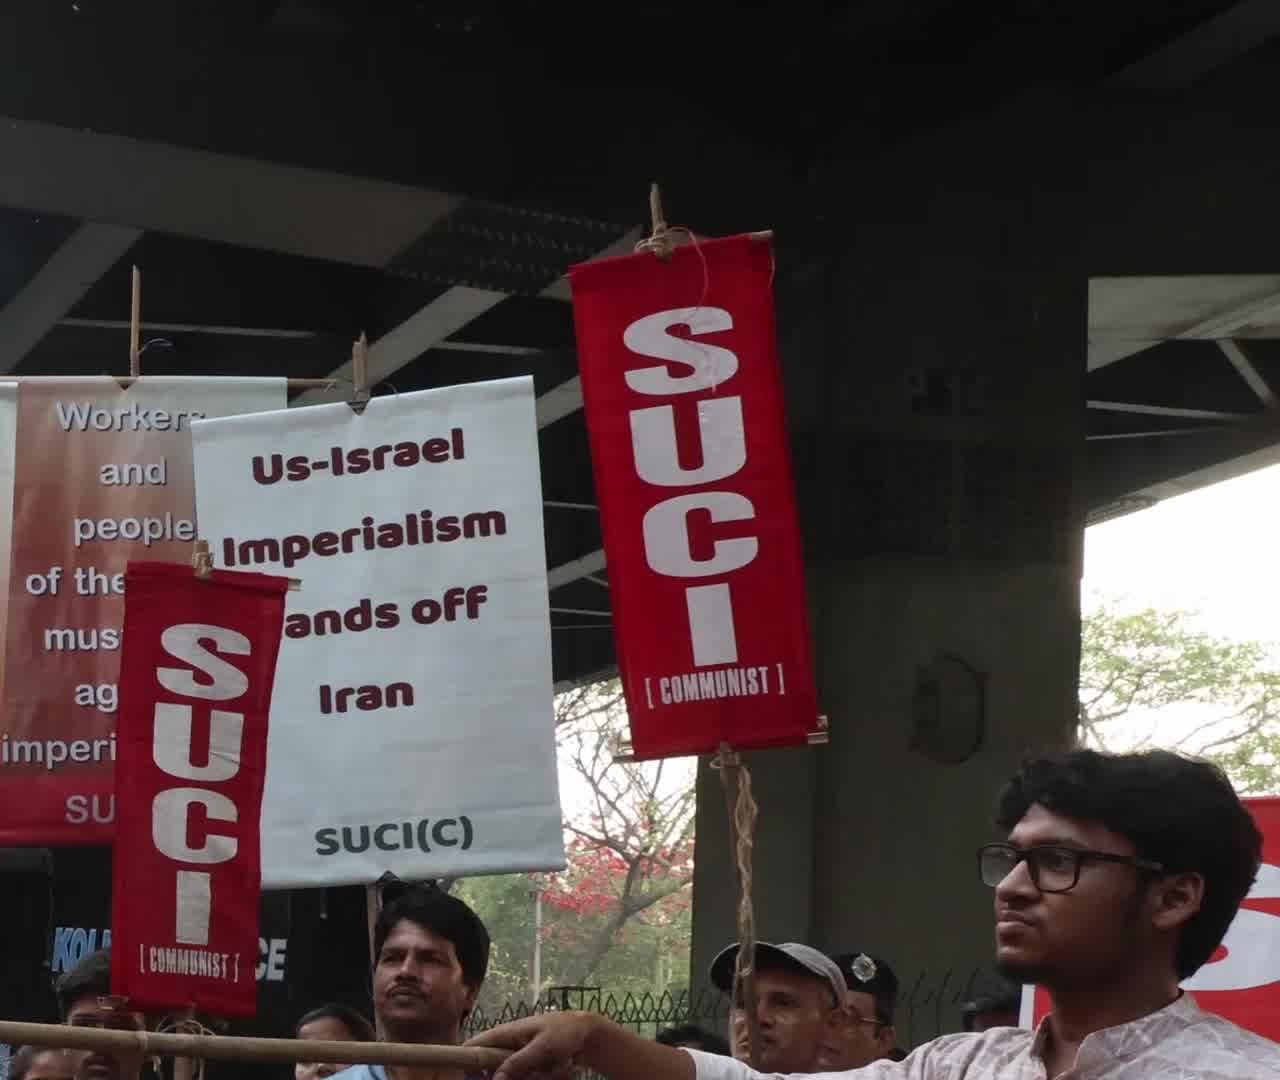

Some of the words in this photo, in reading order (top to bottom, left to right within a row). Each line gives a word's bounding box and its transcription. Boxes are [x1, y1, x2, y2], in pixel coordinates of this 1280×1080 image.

[99, 455, 167, 485] and
[252, 428, 465, 485] Us-Israel
[623, 306, 759, 667] SUCI
[74, 512, 195, 548] people
[223, 510, 507, 568] Imperialism
[26, 567, 64, 596] of
[74, 567, 124, 595] the
[285, 598, 400, 639] ands
[411, 585, 488, 625] off
[44, 627, 123, 651] mus
[319, 682, 414, 714] Iran
[2, 733, 117, 770] imperi
[151, 623, 251, 945] SUCI
[315, 816, 475, 856] SUCI(C)
